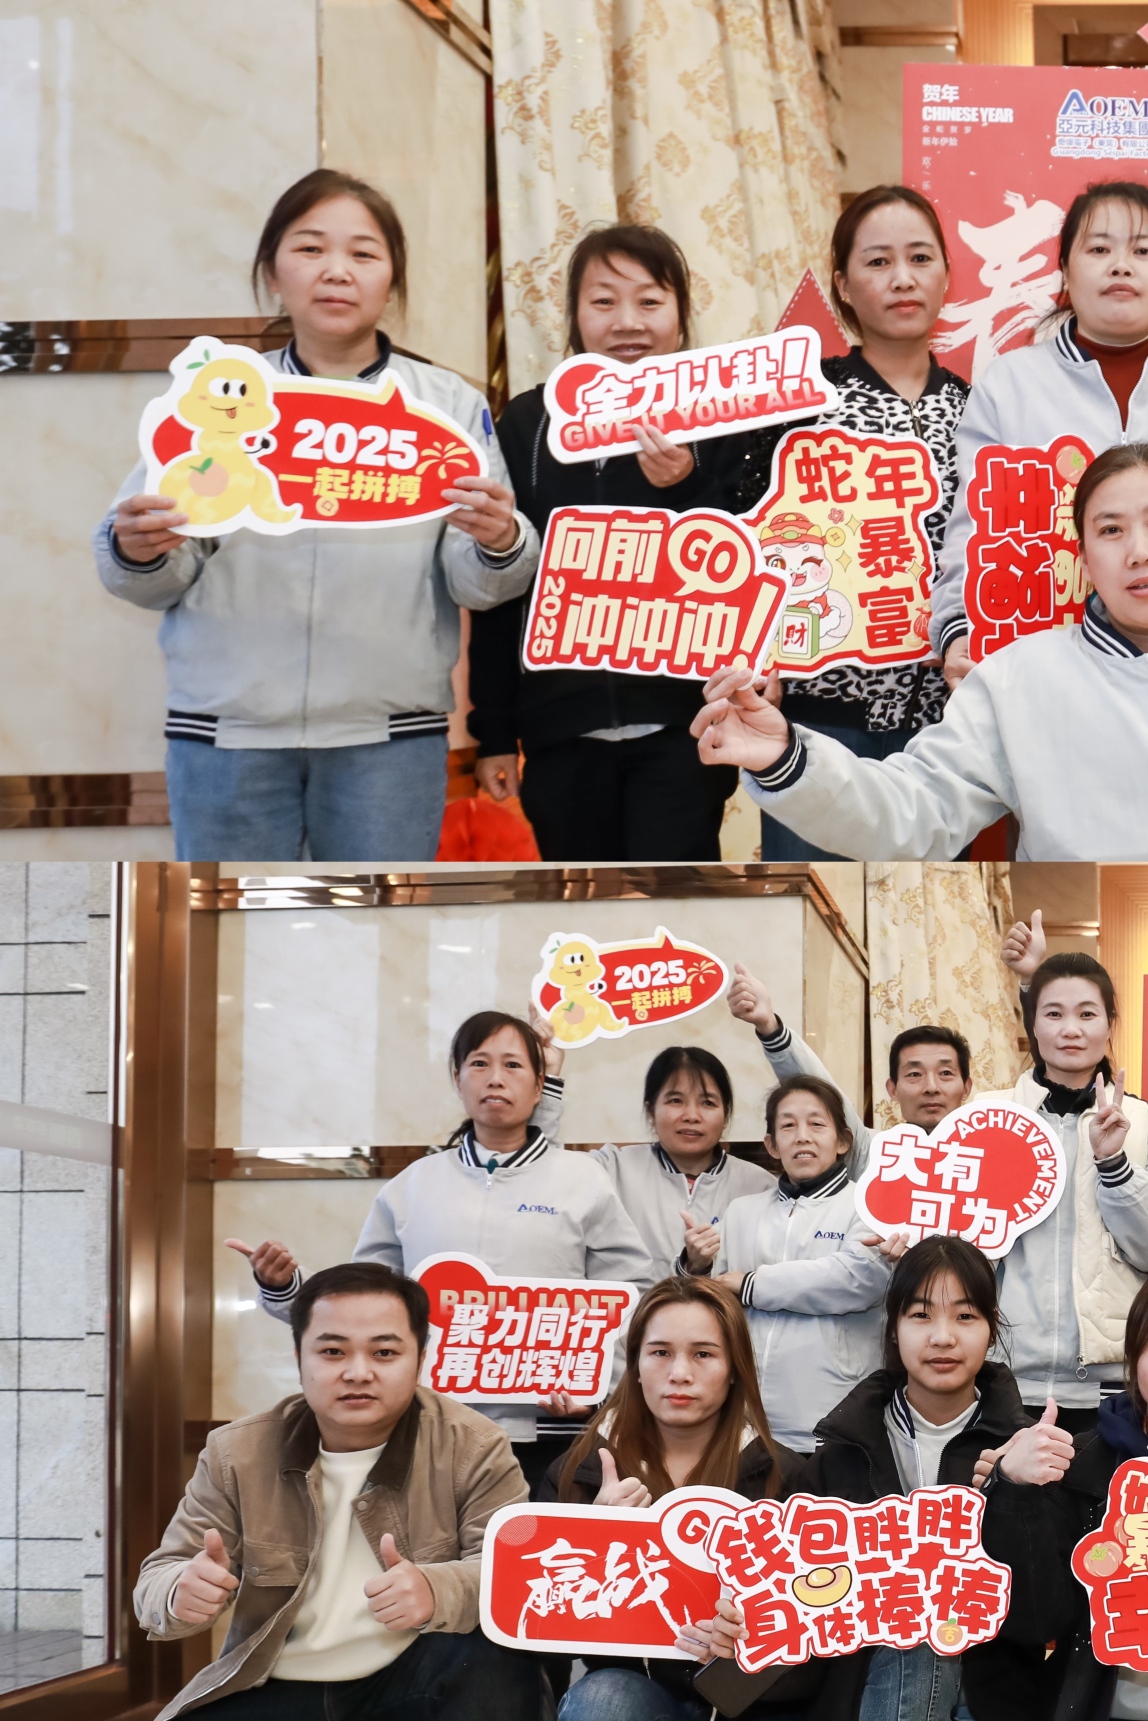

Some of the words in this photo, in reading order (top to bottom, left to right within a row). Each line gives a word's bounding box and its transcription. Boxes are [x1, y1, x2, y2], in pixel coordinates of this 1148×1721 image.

[922, 83, 960, 103] 贺年
[922, 105, 979, 122] CHINESE
[980, 106, 1014, 123] YEAR
[563, 414, 632, 447] GIVE
[641, 409, 669, 434] IT
[675, 391, 759, 426] YOUR
[764, 379, 825, 413] ALL
[291, 418, 419, 470] 2025
[278, 466, 422, 506] 一起拼搏
[795, 444, 924, 509] 蛇年
[548, 516, 664, 583] 向前
[679, 528, 739, 584] GO
[858, 515, 916, 650] 暴富
[531, 575, 566, 658] 2025
[783, 622, 808, 648] 財
[611, 985, 693, 1011] 一起拼搏
[614, 959, 687, 991] 2025
[880, 1134, 985, 1193] 大有
[955, 1109, 1057, 1224] ACHIEVEMENT
[910, 1189, 1008, 1248] 可为
[439, 1289, 624, 1321] BRILLIANT
[446, 1304, 607, 1349] 聚力同行
[437, 1346, 598, 1391] 再创辉煌
[677, 1509, 710, 1545] G
[716, 1494, 976, 1587] 钱包胖胖
[741, 1566, 1002, 1665] 身体棒棒
